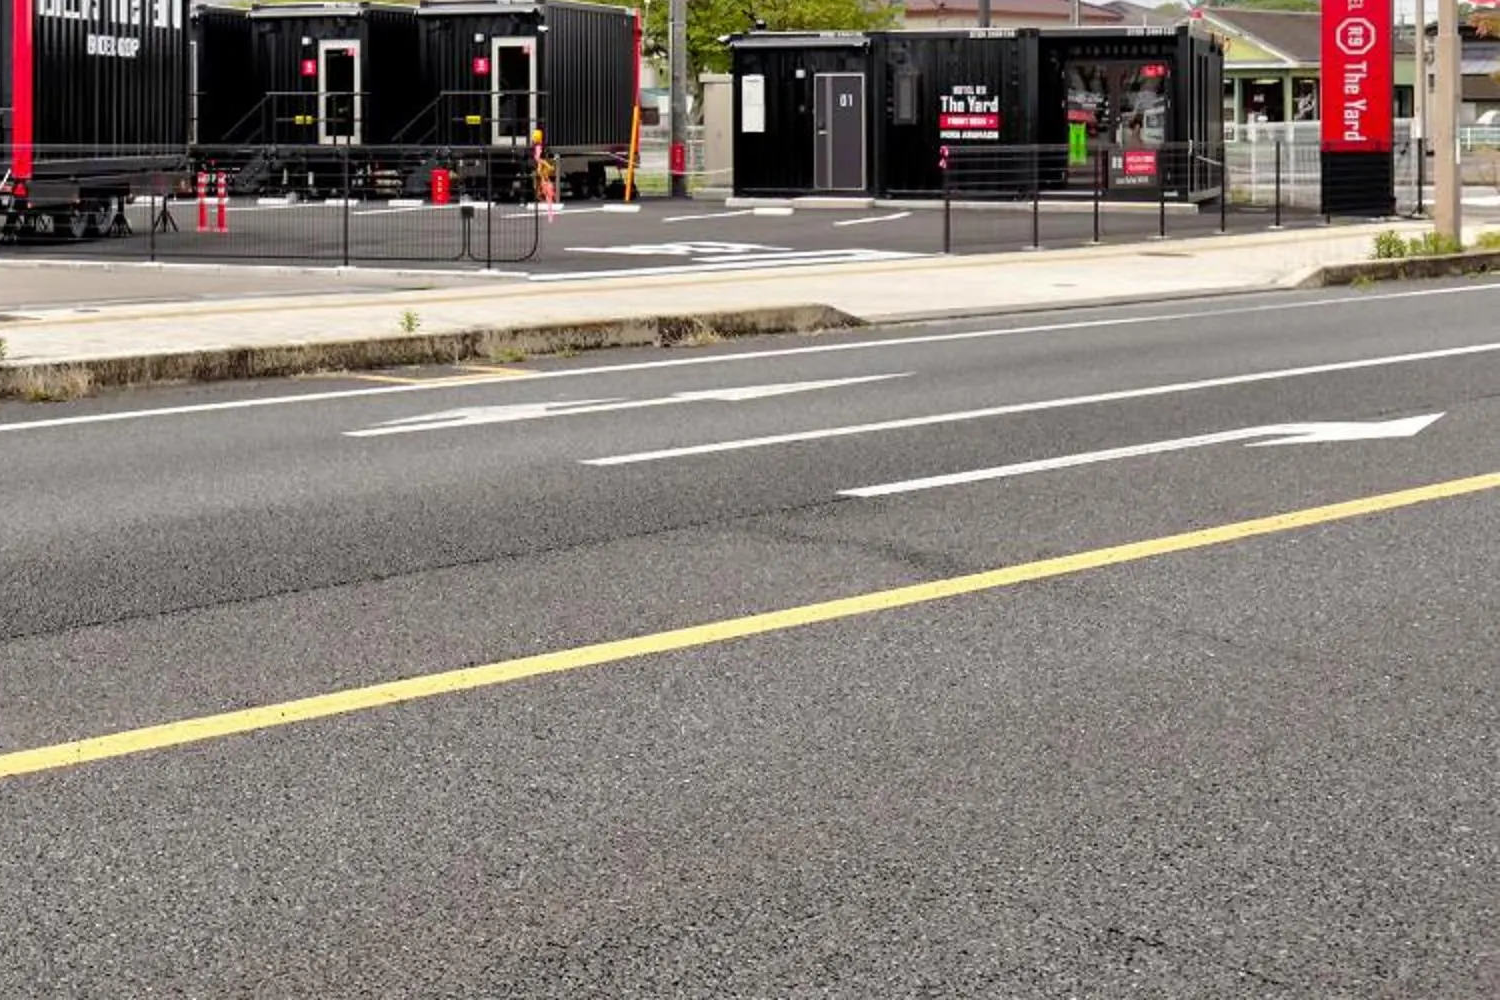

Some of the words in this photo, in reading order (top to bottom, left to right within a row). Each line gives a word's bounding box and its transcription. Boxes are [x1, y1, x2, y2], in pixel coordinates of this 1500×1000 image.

[1347, 25, 1365, 47] R9
[1343, 61, 1368, 95] The
[839, 93, 853, 107] 01
[940, 95, 965, 113] The
[967, 95, 999, 113] Yard
[1343, 99, 1368, 142] Yard
